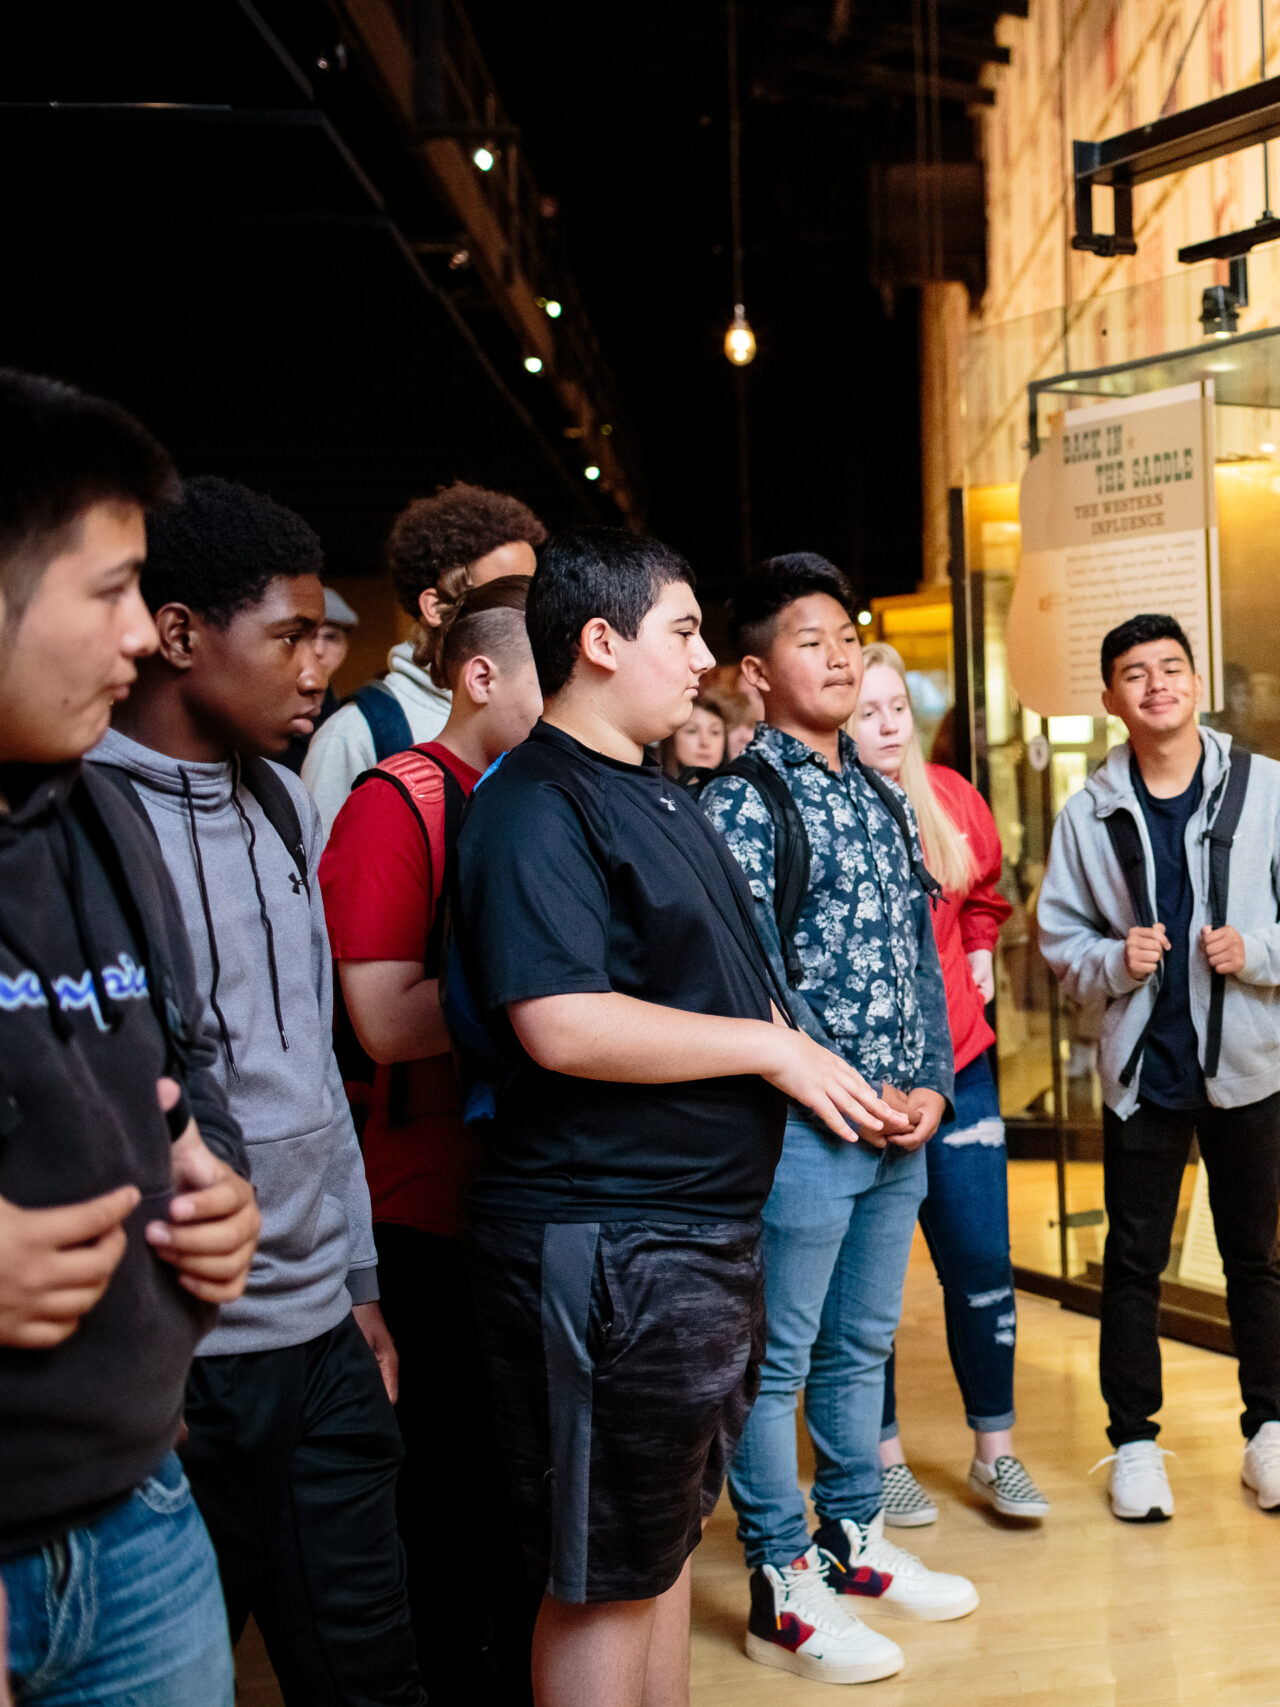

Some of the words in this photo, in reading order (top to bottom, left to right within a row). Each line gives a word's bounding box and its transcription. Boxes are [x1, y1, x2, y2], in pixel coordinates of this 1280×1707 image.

[1106, 424, 1123, 457] IN
[1096, 460, 1125, 495] THE
[1132, 448, 1193, 488] SADDLE
[1074, 502, 1099, 520] THE
[1101, 492, 1164, 515] WESTERN
[1090, 511, 1165, 536] INFLUENCE
